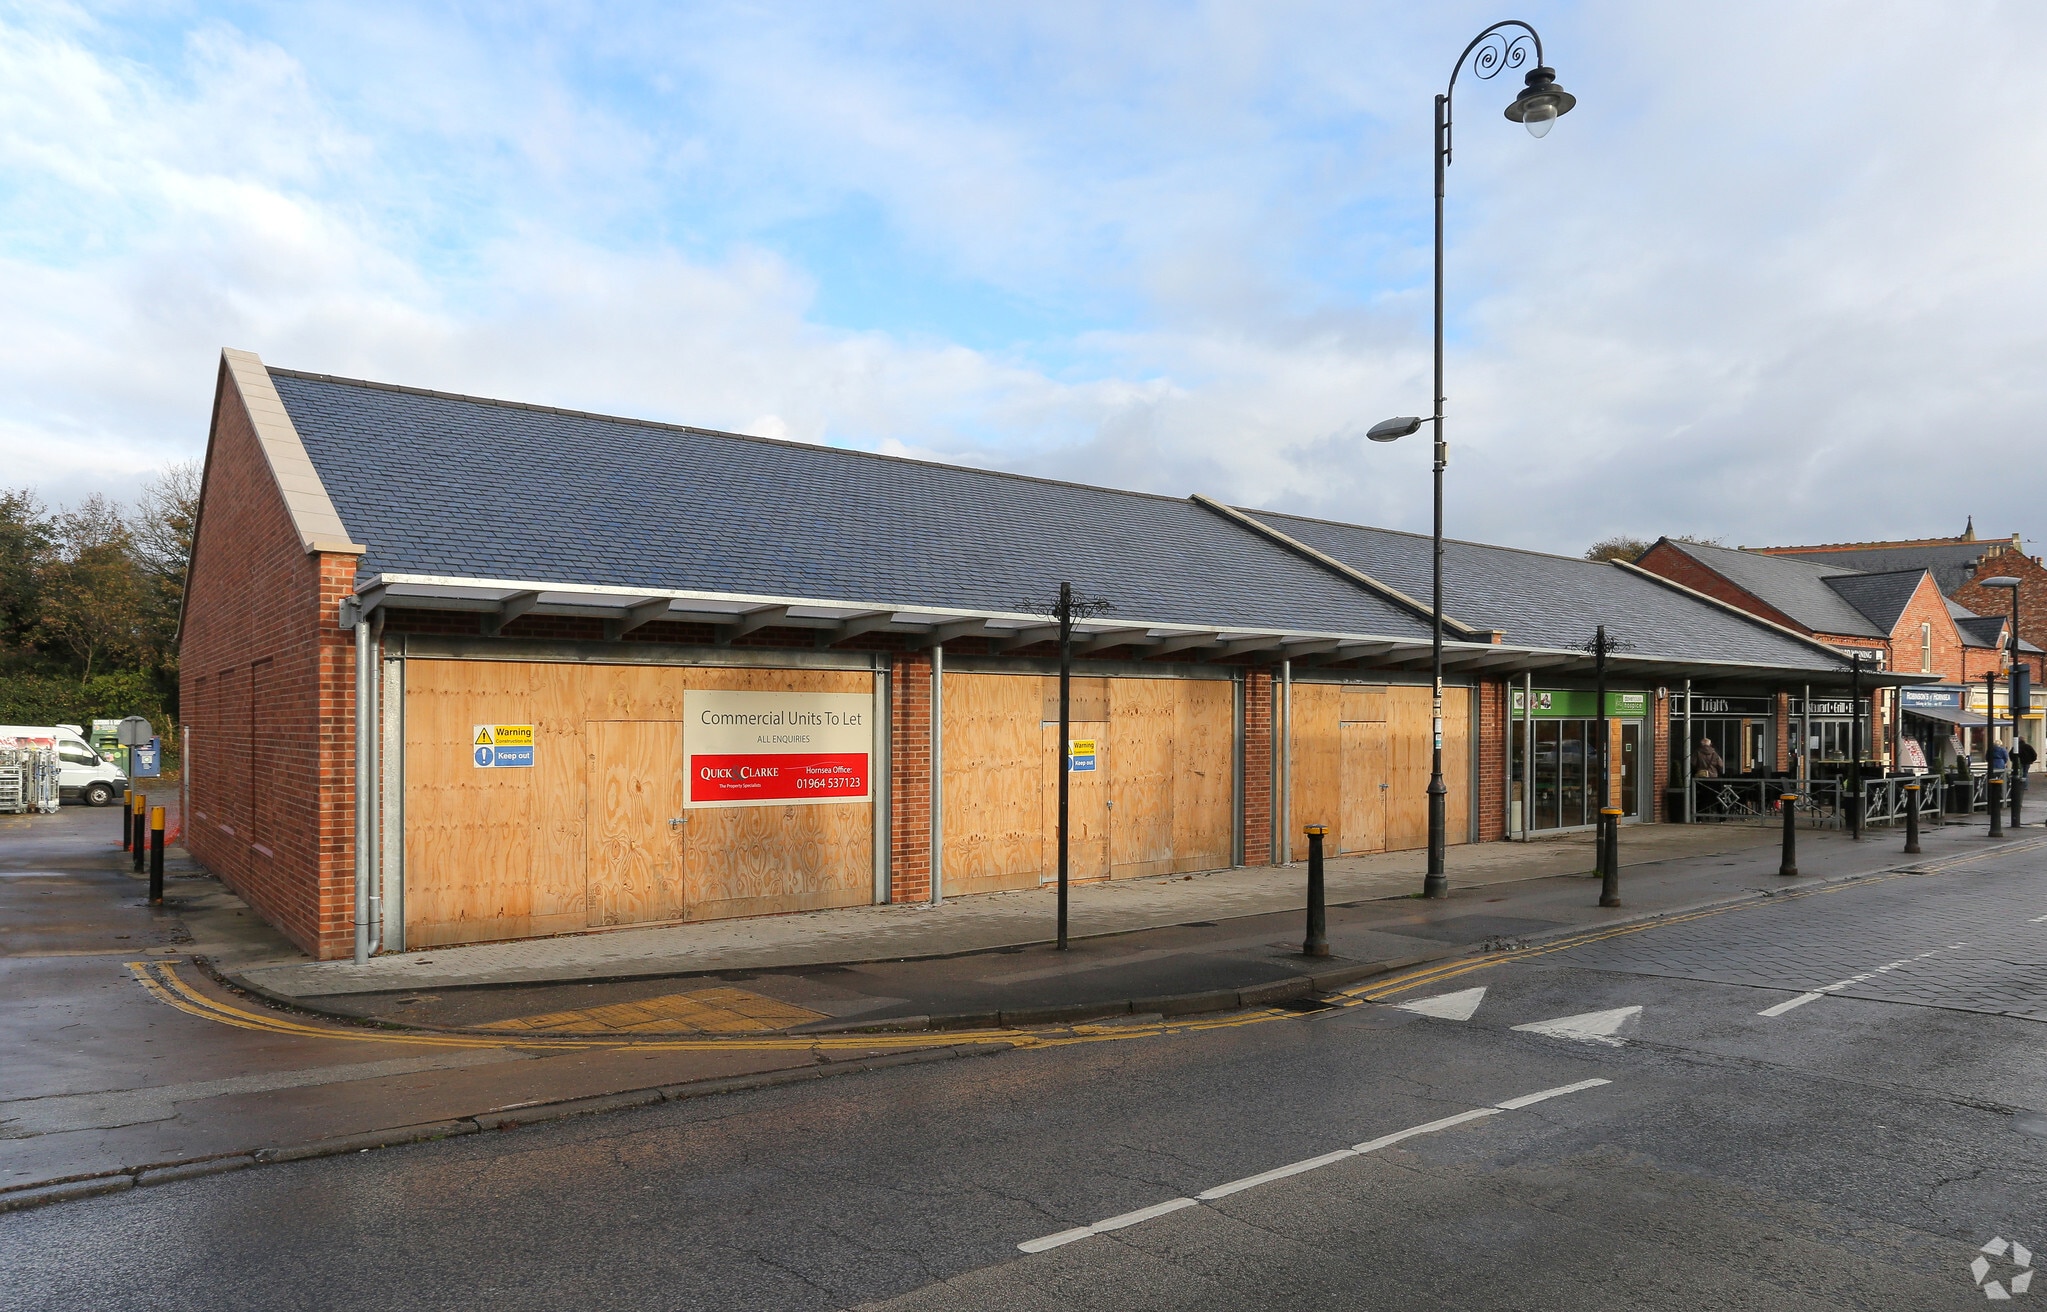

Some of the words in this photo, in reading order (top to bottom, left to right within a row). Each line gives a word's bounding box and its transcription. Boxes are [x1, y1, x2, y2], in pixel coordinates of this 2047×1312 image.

[1834, 702, 1845, 713] Grill
[701, 710, 784, 725] Commercial
[788, 711, 822, 725] Units
[824, 712, 840, 725] To
[843, 712, 862, 726] Let
[497, 728, 531, 737] Warning
[772, 735, 810, 744] ENQUIRIES
[498, 752, 517, 760] Keep
[806, 766, 832, 774] Hornsea
[796, 778, 826, 789] 01964
[828, 778, 861, 788] 537123
